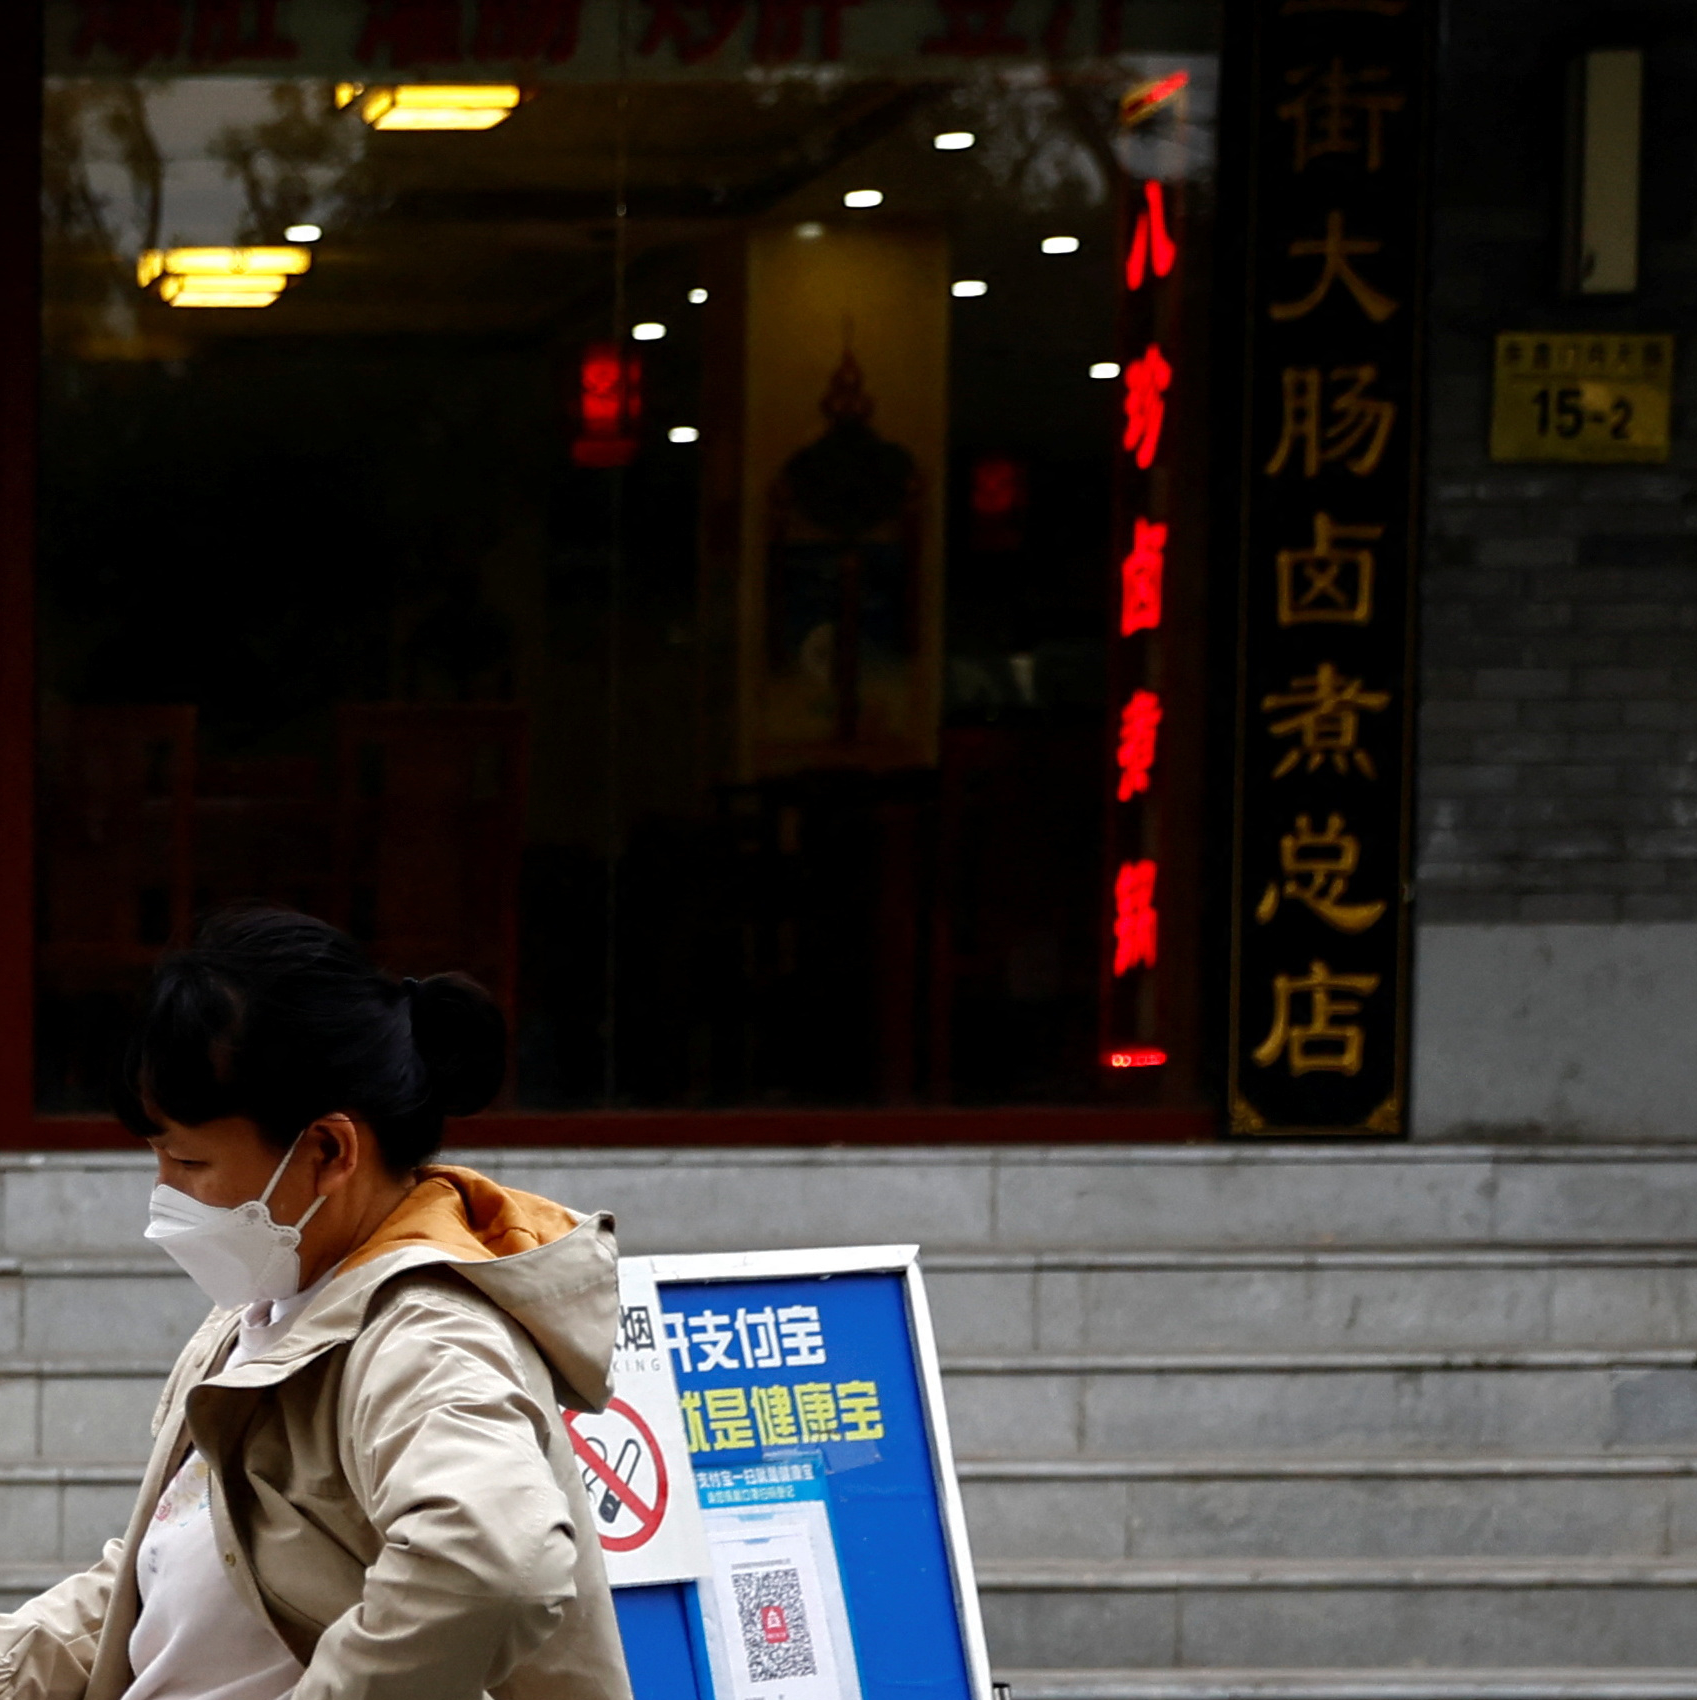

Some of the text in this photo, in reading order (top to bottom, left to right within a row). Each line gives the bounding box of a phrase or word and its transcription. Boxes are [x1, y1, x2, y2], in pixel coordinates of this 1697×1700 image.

[1532, 388, 1634, 440] 15-2
[1252, 0, 1411, 1077] 街大肠卤煮总店
[615, 1305, 657, 1352] 烟
